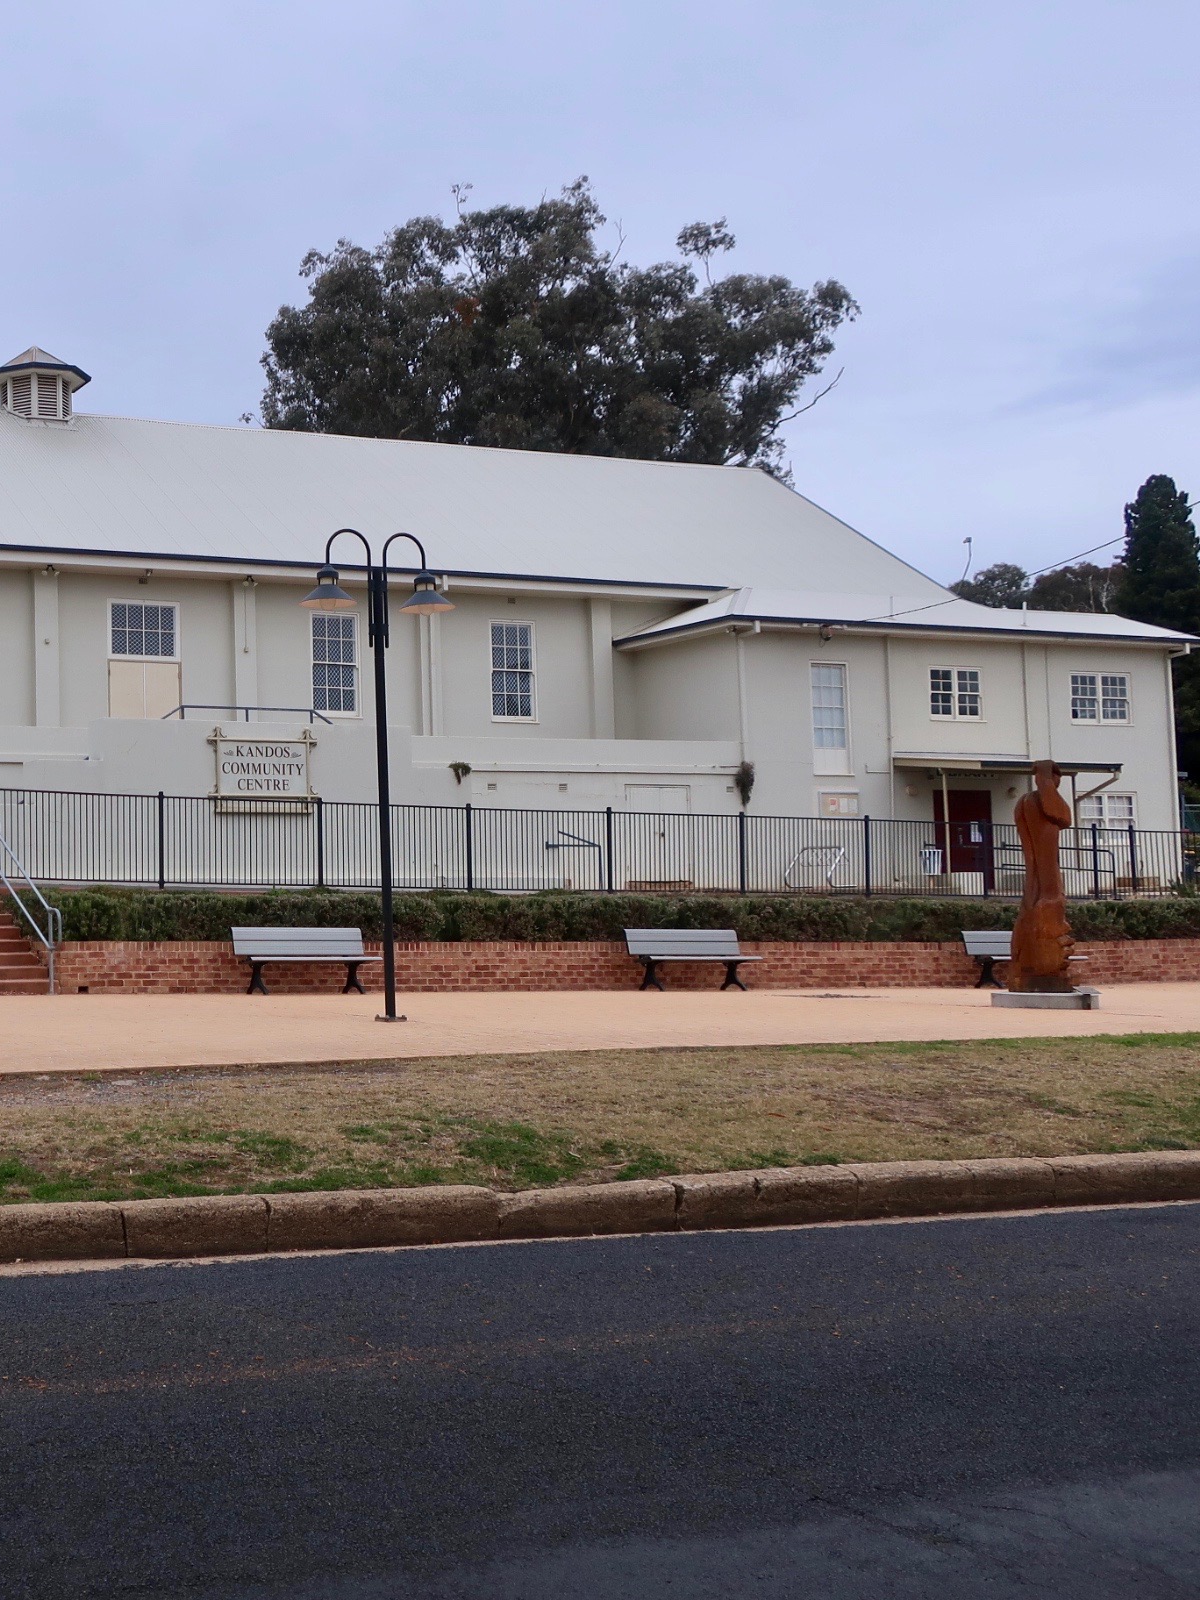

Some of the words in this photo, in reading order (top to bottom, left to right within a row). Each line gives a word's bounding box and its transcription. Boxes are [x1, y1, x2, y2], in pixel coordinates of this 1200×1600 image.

[236, 745, 291, 758] KANDOS
[222, 762, 304, 776] COMMUNITY
[237, 778, 290, 791] CENTRE
